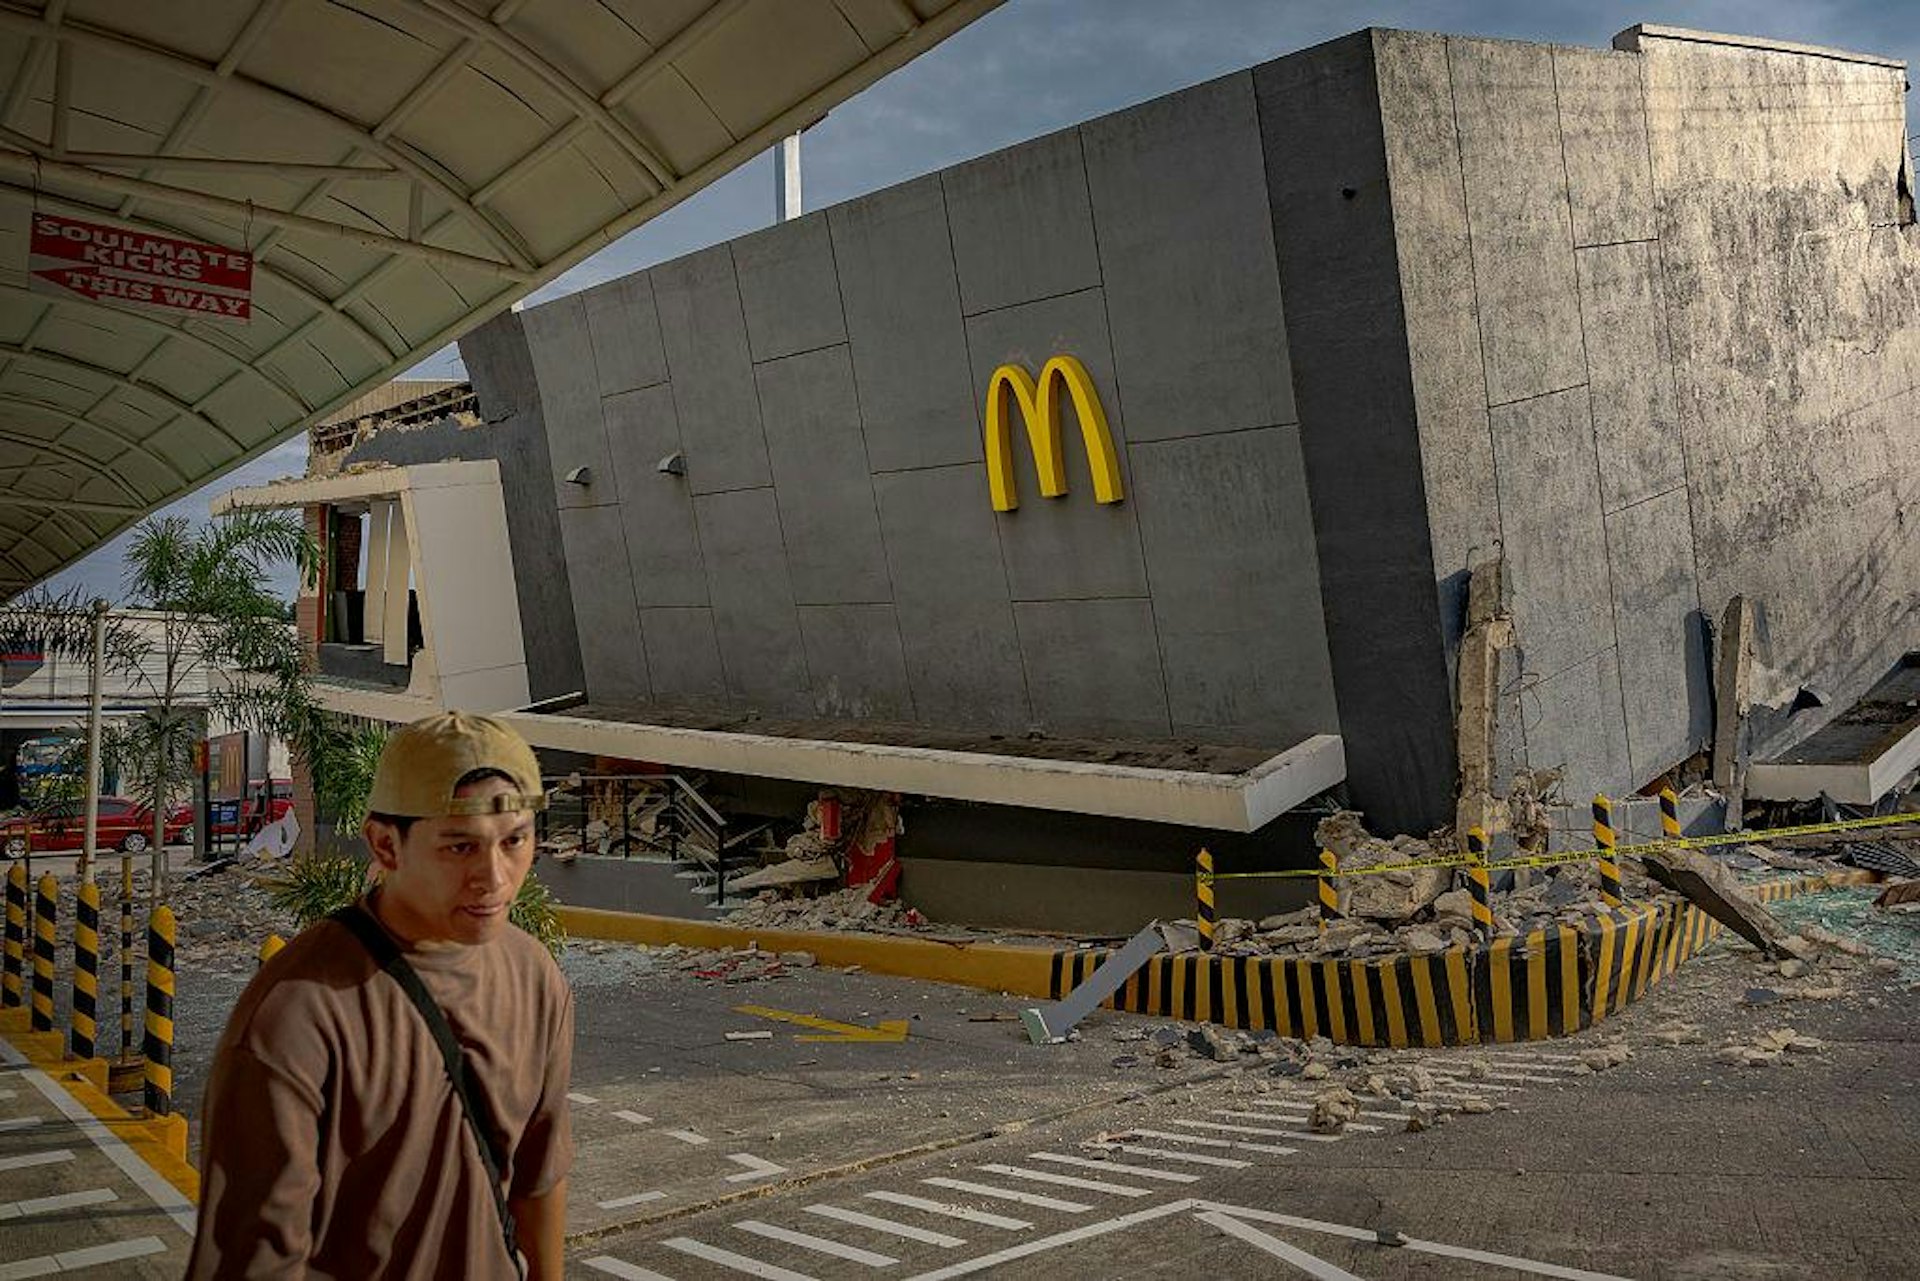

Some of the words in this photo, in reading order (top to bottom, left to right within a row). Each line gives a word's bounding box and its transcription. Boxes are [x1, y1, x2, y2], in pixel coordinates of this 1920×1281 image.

[37, 220, 249, 271] SOULMATE
[84, 245, 202, 279] KICKS
[65, 271, 153, 299] THIS
[163, 287, 244, 315] WAY
